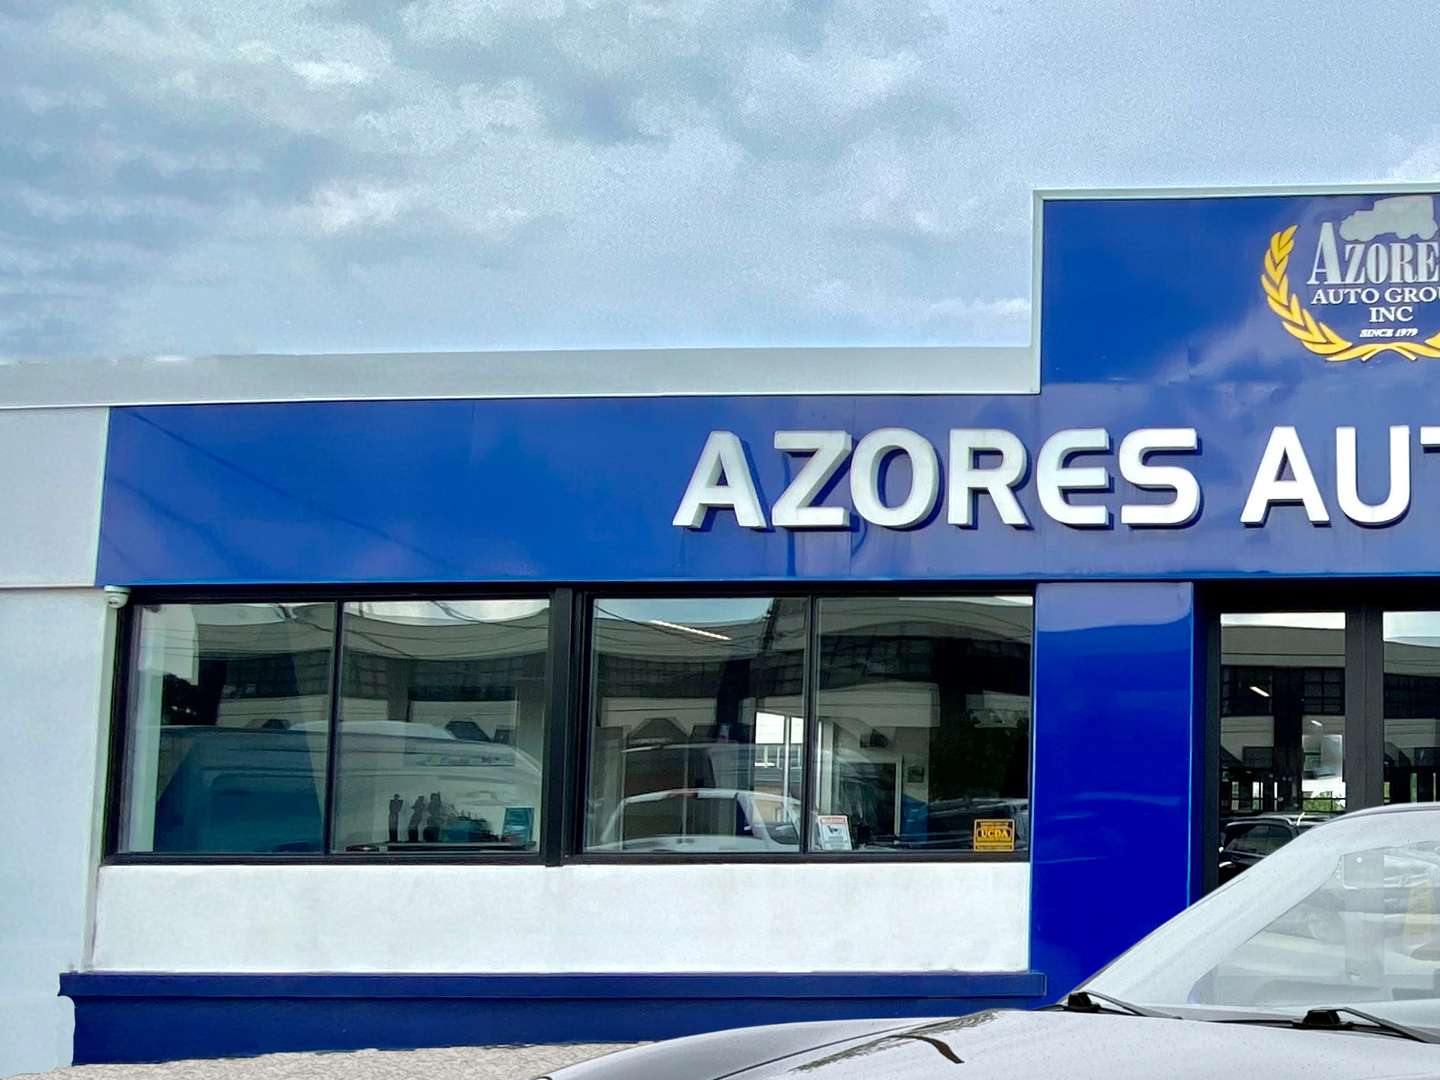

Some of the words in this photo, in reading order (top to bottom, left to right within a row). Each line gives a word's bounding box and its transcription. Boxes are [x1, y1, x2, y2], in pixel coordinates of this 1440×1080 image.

[1312, 288, 1380, 305] AUTO
[1369, 307, 1413, 322] INC
[1360, 329, 1394, 338] SINCE
[1395, 328, 1418, 337] 1979
[672, 427, 1201, 530] AZORES
[980, 829, 1009, 839] UCDA
